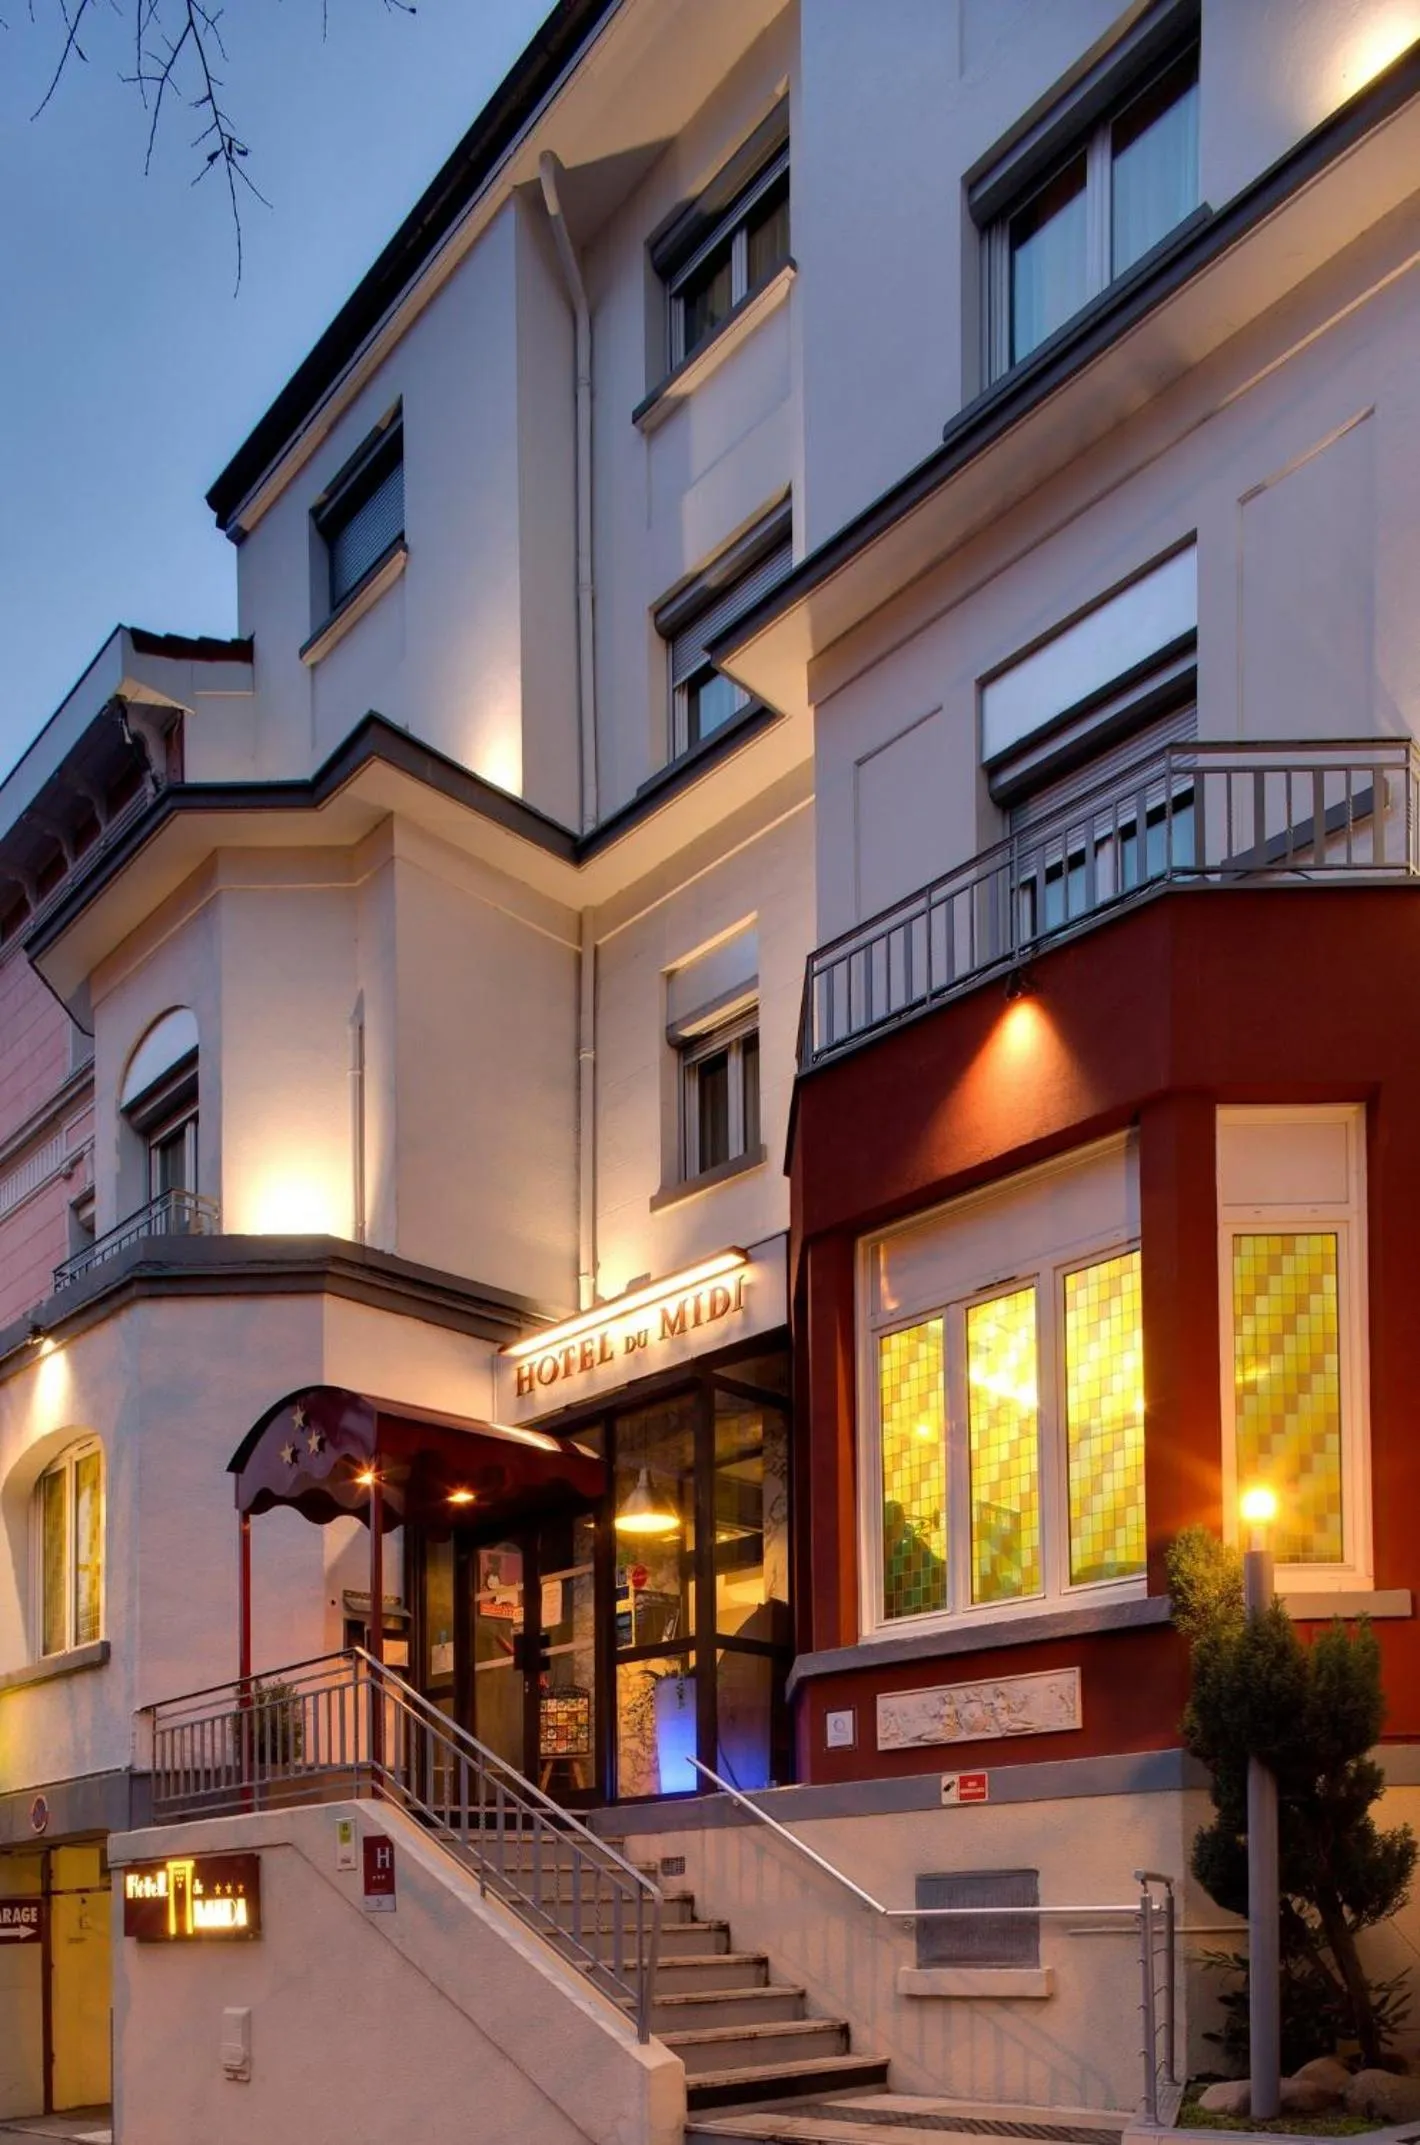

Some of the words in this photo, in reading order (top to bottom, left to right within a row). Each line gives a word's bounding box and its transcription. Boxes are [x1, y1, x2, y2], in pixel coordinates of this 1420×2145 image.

[516, 1332, 614, 1397] HOTEL
[623, 1328, 648, 1355] DU
[658, 1275, 745, 1341] MIDI
[376, 1847, 390, 1869] H
